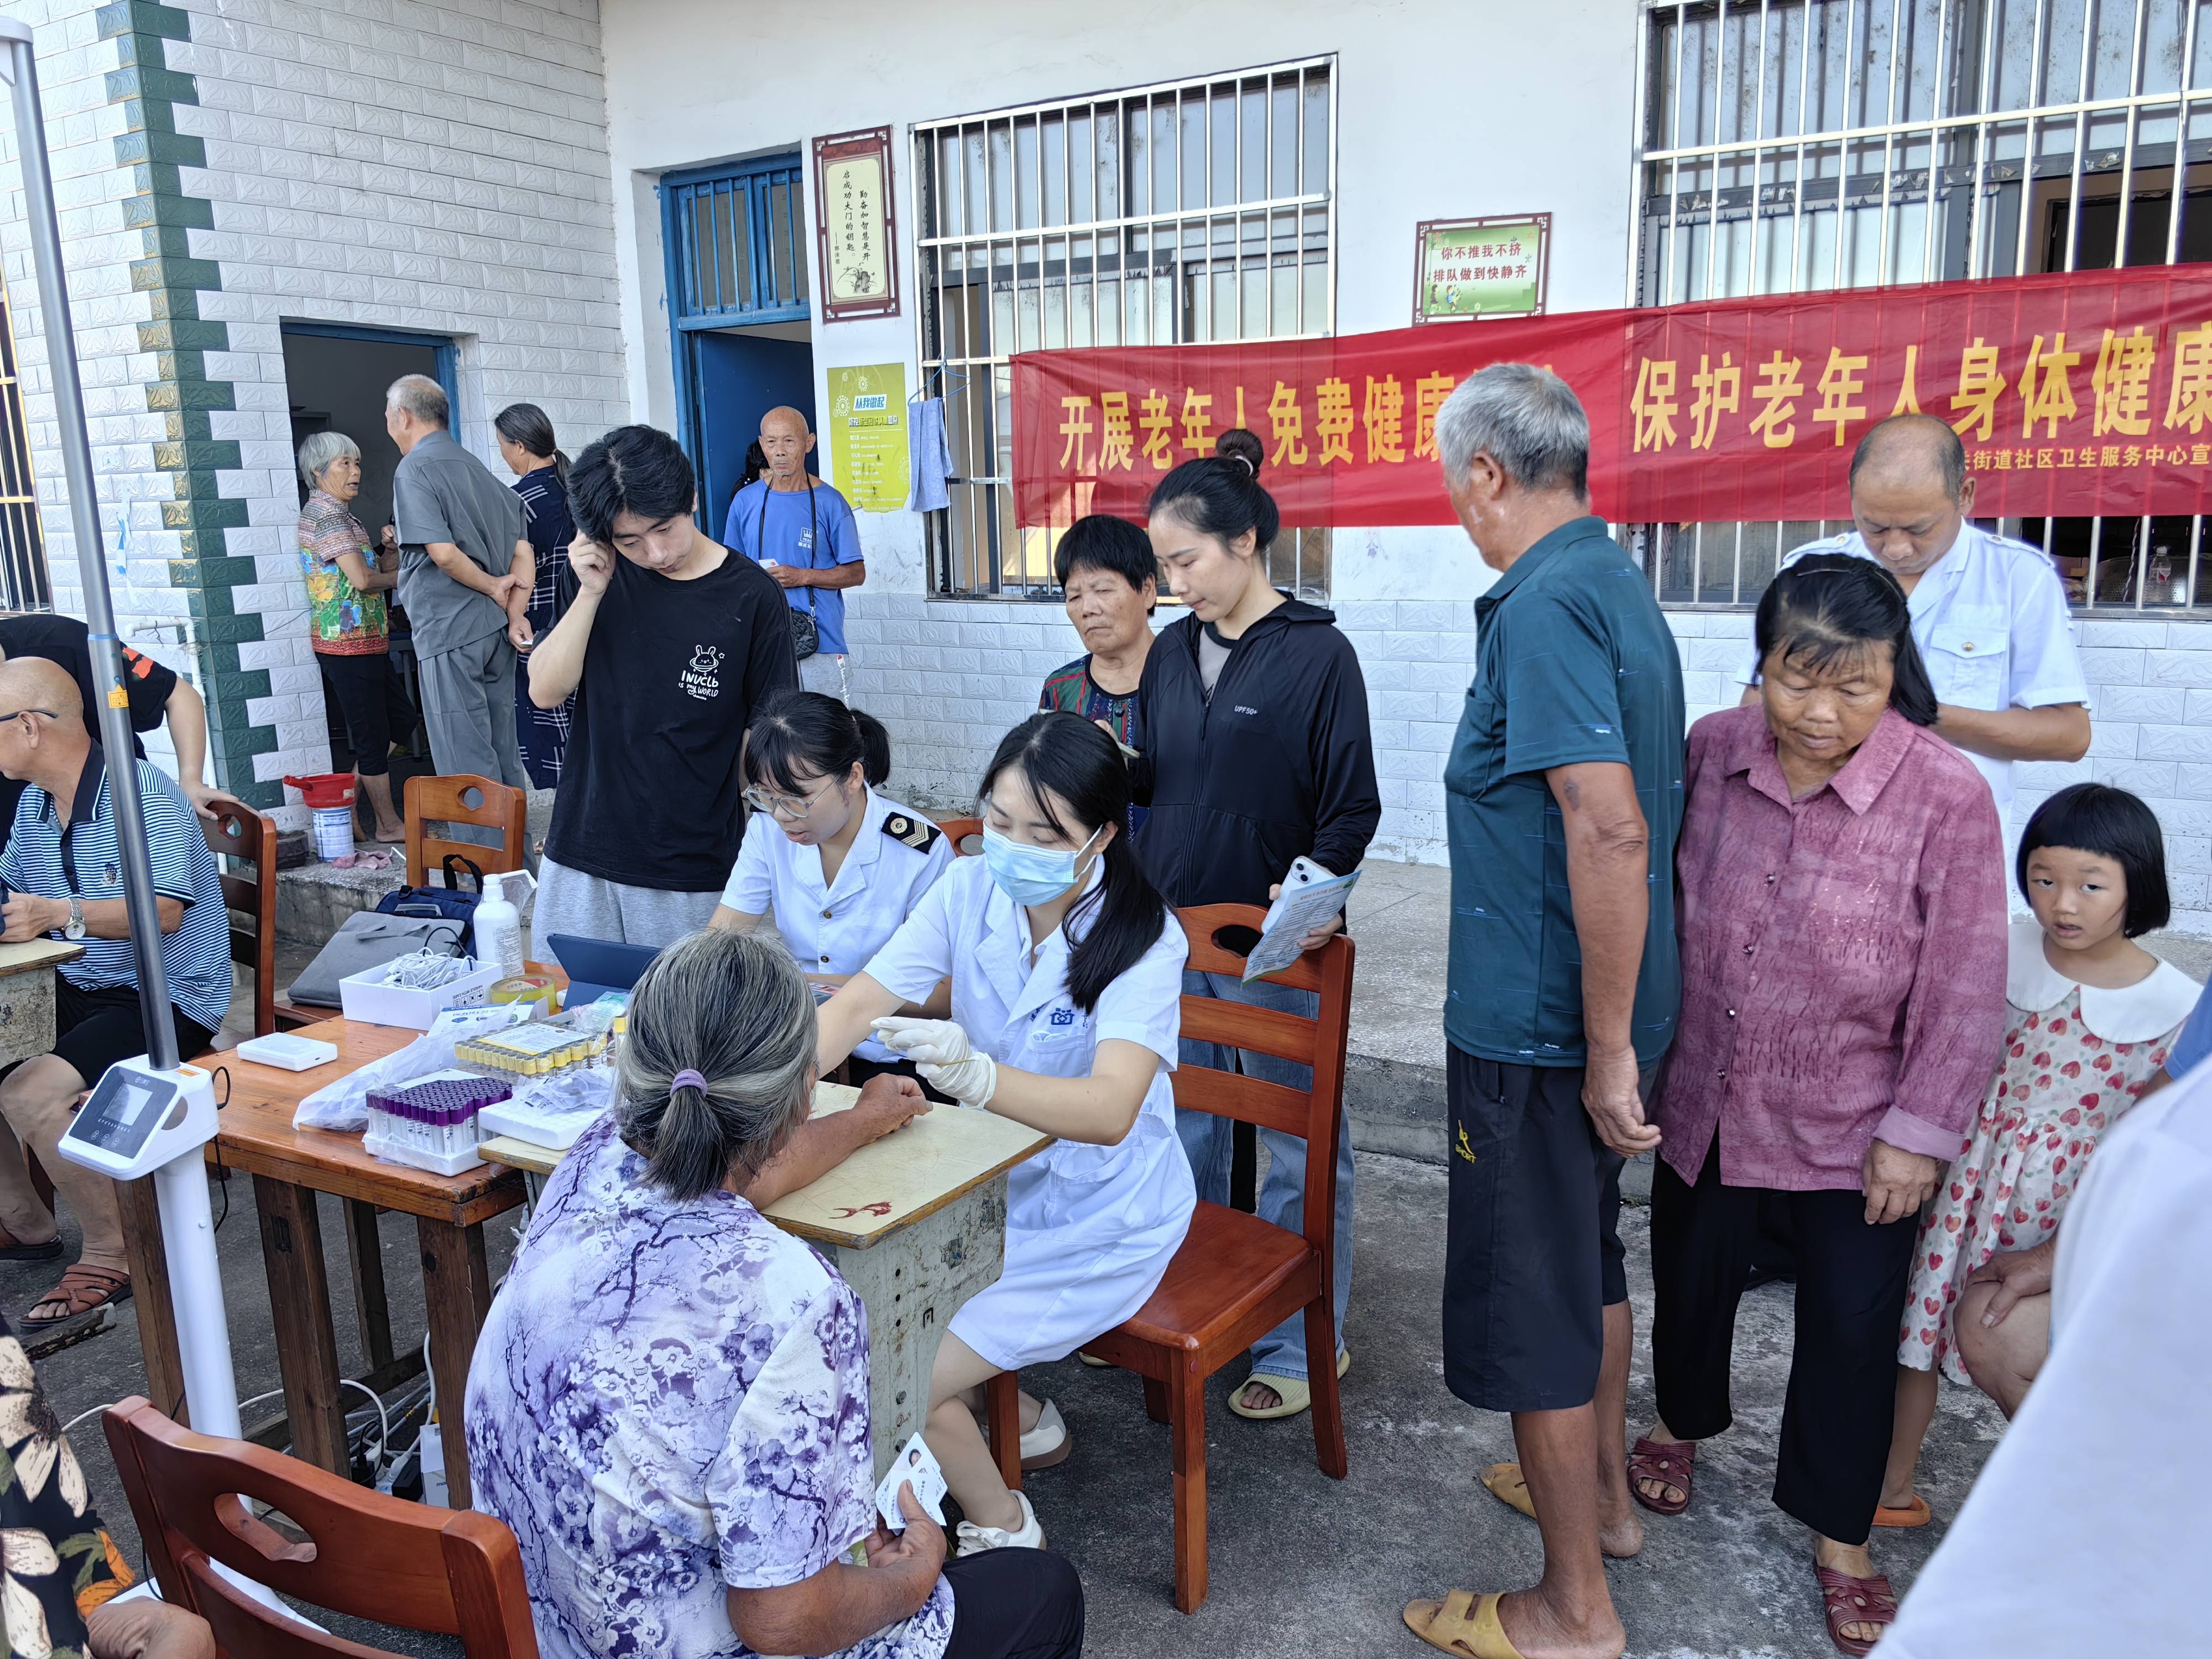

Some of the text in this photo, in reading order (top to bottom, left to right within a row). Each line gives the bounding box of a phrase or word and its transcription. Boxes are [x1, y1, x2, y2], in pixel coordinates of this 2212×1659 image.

[859, 190, 870, 261] 勤奋加智慧是开
[1441, 243, 1522, 260] 你不推我不挤
[1433, 264, 1527, 283] 排队做到快静齐
[855, 397, 885, 409] 从我做起
[1234, 705, 1258, 715] UPF50+
